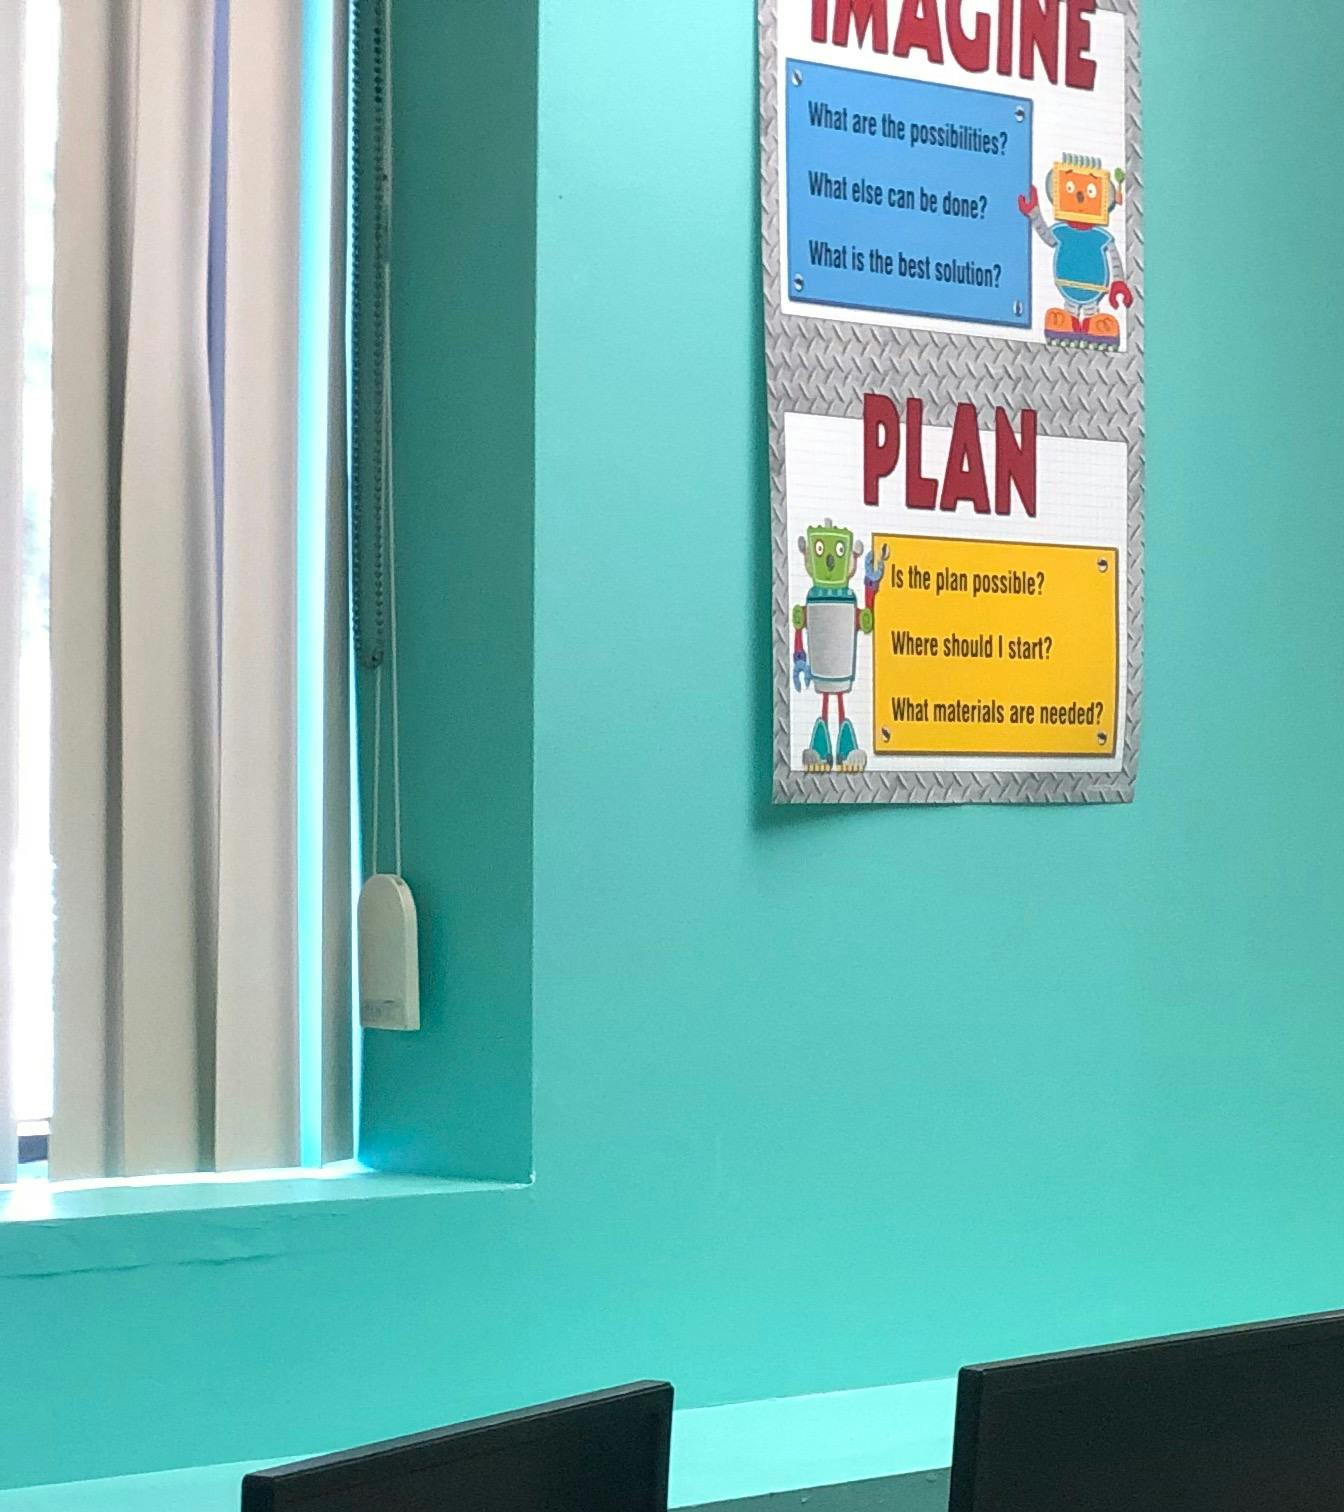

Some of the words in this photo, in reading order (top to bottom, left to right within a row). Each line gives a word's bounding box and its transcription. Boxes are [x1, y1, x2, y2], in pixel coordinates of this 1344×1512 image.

[808, 101, 847, 131] What
[853, 113, 875, 135] are
[882, 113, 905, 139] the
[911, 122, 1008, 155] possibilities?
[808, 171, 847, 200] What
[853, 179, 883, 207] else
[888, 187, 915, 210] can
[920, 187, 938, 213] be
[943, 190, 987, 219] done?
[809, 240, 847, 269] What
[853, 246, 865, 272] is
[870, 250, 893, 275] the
[899, 253, 930, 279] best
[936, 256, 1001, 288] solution?
[864, 393, 1037, 518] PLAN
[891, 564, 903, 589] Is
[908, 565, 930, 590] the
[936, 567, 967, 597] plan
[973, 571, 1044, 597] possible?
[891, 631, 937, 656] Where
[943, 634, 993, 658] should
[998, 636, 1003, 658] I
[1008, 636, 1052, 659] start?
[891, 697, 929, 722] What
[934, 699, 1003, 724] materials
[1009, 706, 1033, 724] are
[1040, 701, 1103, 726] needed?
